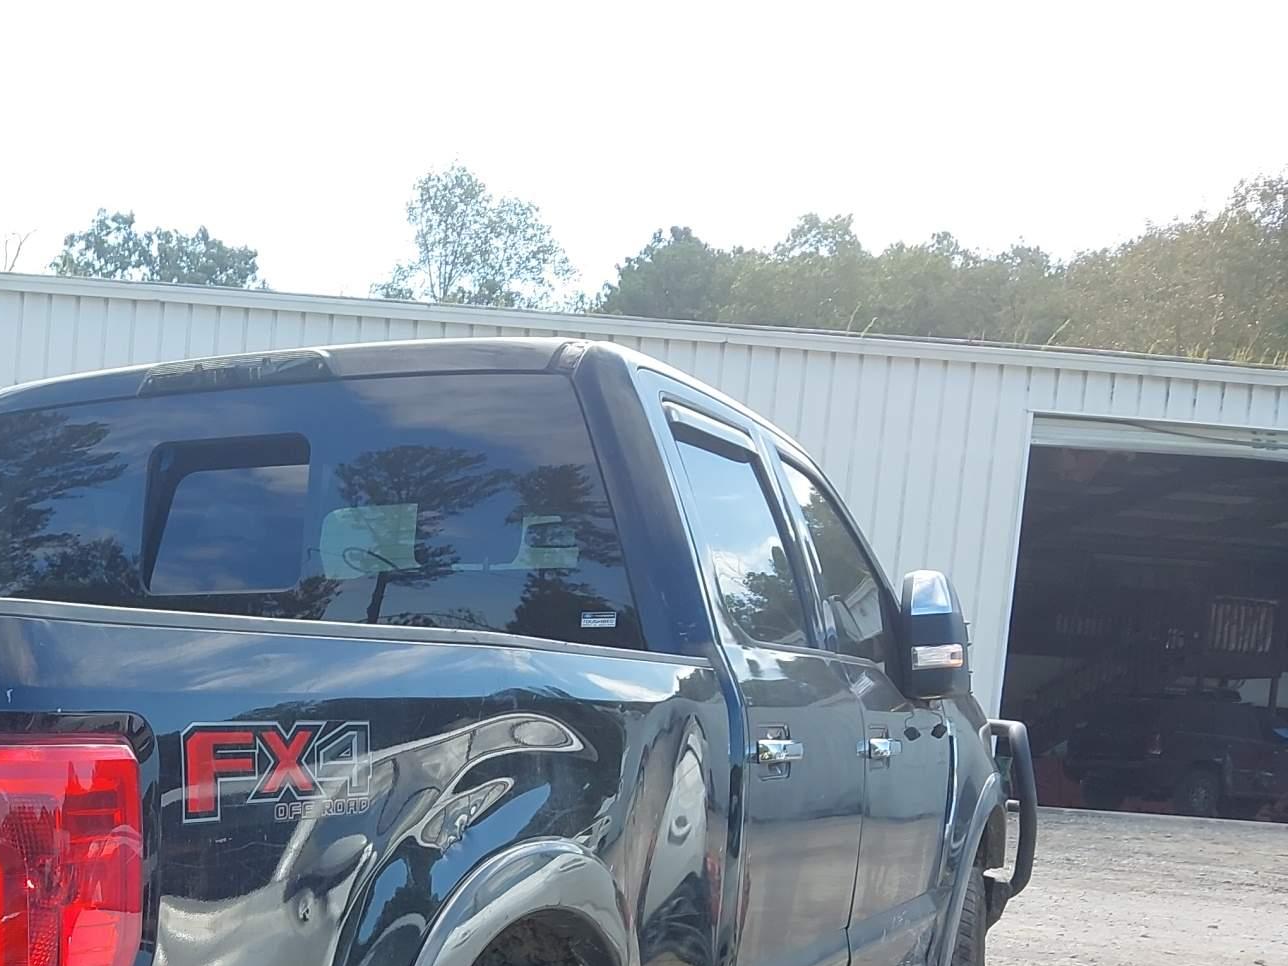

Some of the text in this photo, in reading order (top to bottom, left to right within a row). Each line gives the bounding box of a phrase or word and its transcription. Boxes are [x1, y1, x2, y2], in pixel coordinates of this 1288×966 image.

[181, 719, 373, 824] FX4
[274, 797, 370, 821] OFF ROAD
